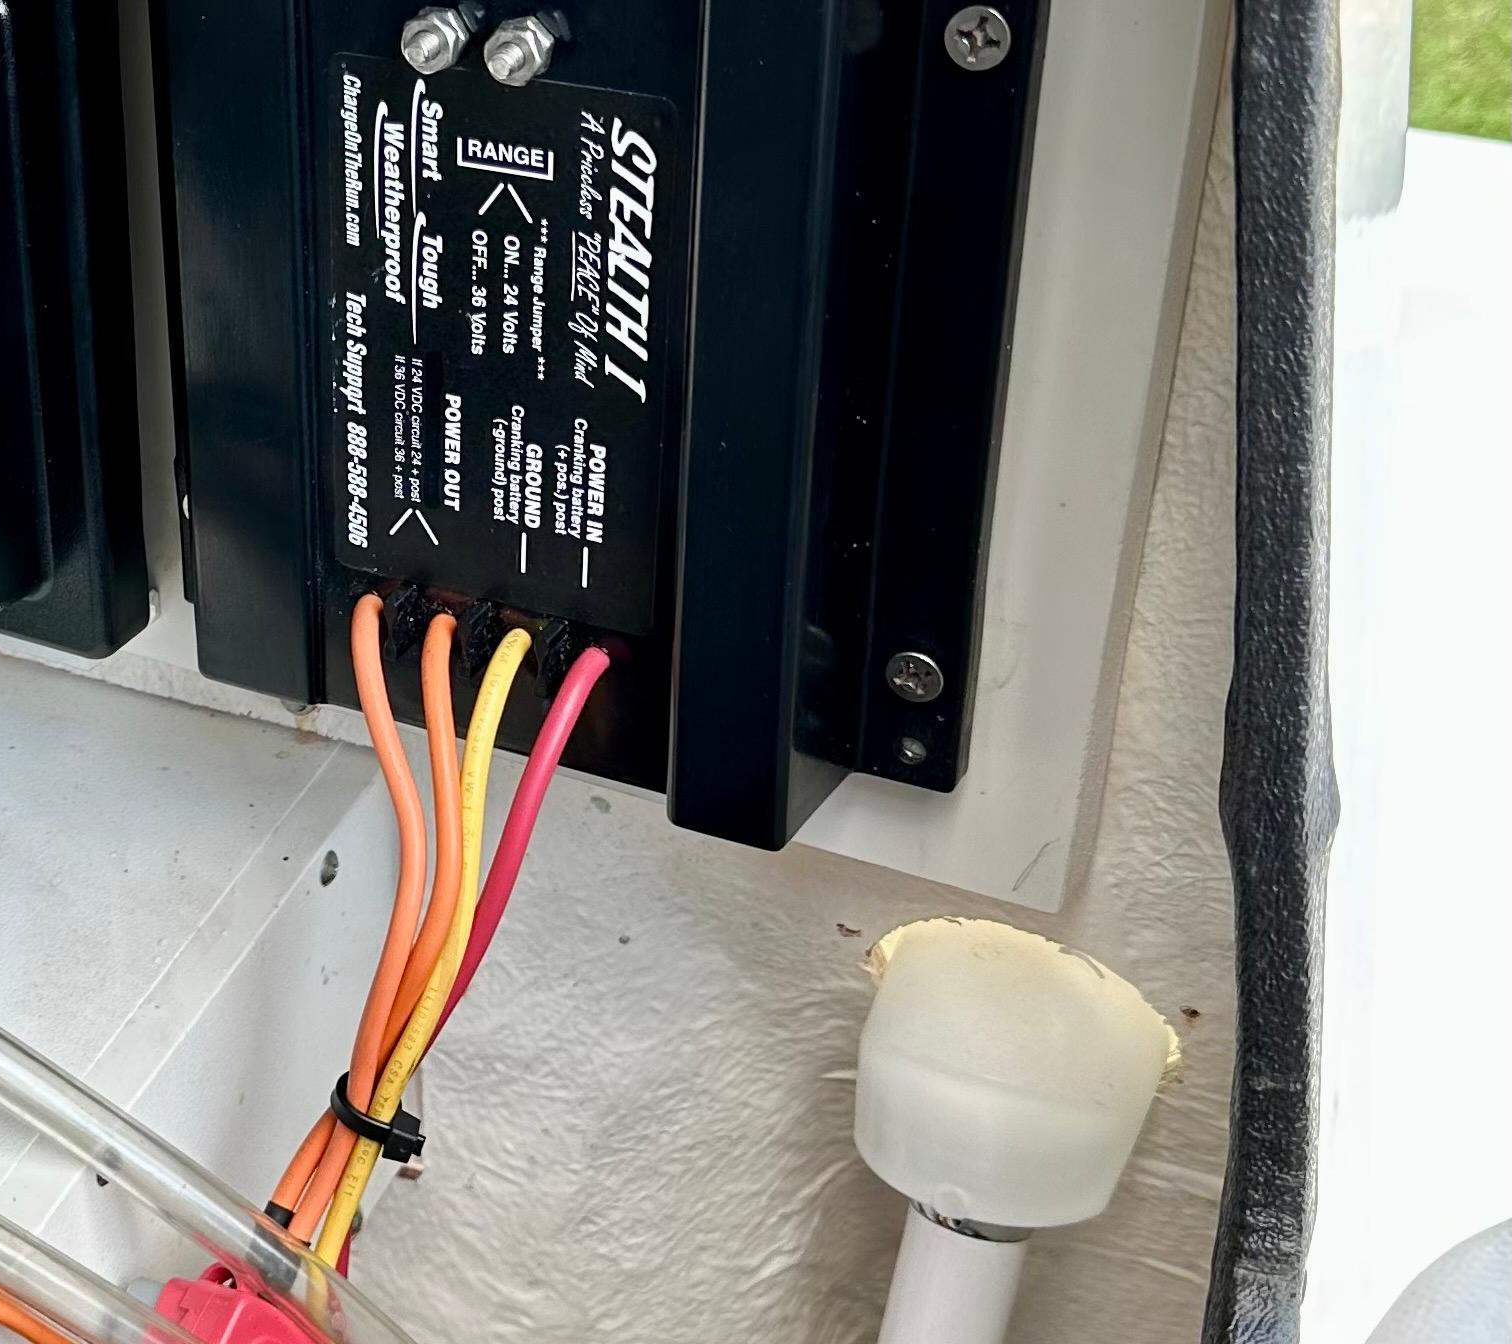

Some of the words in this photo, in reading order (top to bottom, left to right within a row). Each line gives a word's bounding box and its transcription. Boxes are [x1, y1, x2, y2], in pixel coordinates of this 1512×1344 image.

[341, 74, 363, 247] ChargeOnTheRun.com
[421, 99, 444, 182] Smart
[468, 138, 545, 169] RANGE
[579, 136, 605, 221] Priceless
[381, 121, 406, 305] Weatherproof
[471, 229, 488, 281] OFF...
[503, 235, 521, 279] ON...
[606, 117, 657, 362] STEALTH
[418, 235, 443, 309] Tough
[530, 246, 547, 294] Range
[345, 291, 368, 337] Tech
[471, 285, 487, 307] 36
[503, 283, 519, 306] 24
[470, 312, 487, 356] Volts
[502, 311, 519, 355] Volts
[530, 296, 546, 352] Jumper
[568, 312, 598, 342] Of
[342, 339, 368, 415] Support
[394, 363, 406, 381] 36
[411, 366, 423, 384] 24
[573, 340, 598, 389] Mind
[604, 354, 647, 404] I
[394, 383, 406, 410] VDC
[411, 387, 423, 413] VDC
[394, 412, 405, 446] circuit
[411, 415, 423, 449] circuit
[444, 393, 462, 465] POWER
[507, 405, 525, 471] Cranking
[569, 418, 589, 485] Cranking
[394, 447, 405, 463] 36
[411, 450, 422, 465] 24
[491, 418, 509, 486] (-ground)
[347, 421, 368, 548] 888-588-4506
[392, 474, 404, 499] post
[409, 478, 421, 503] post
[444, 469, 461, 512] OUT
[505, 473, 523, 525] battery
[524, 443, 543, 529] GROUND
[553, 461, 569, 499] pos.)
[587, 443, 607, 517] POWER
[491, 487, 506, 521] post
[552, 501, 567, 535] post
[567, 488, 585, 539] battery
[585, 520, 603, 544] IN
